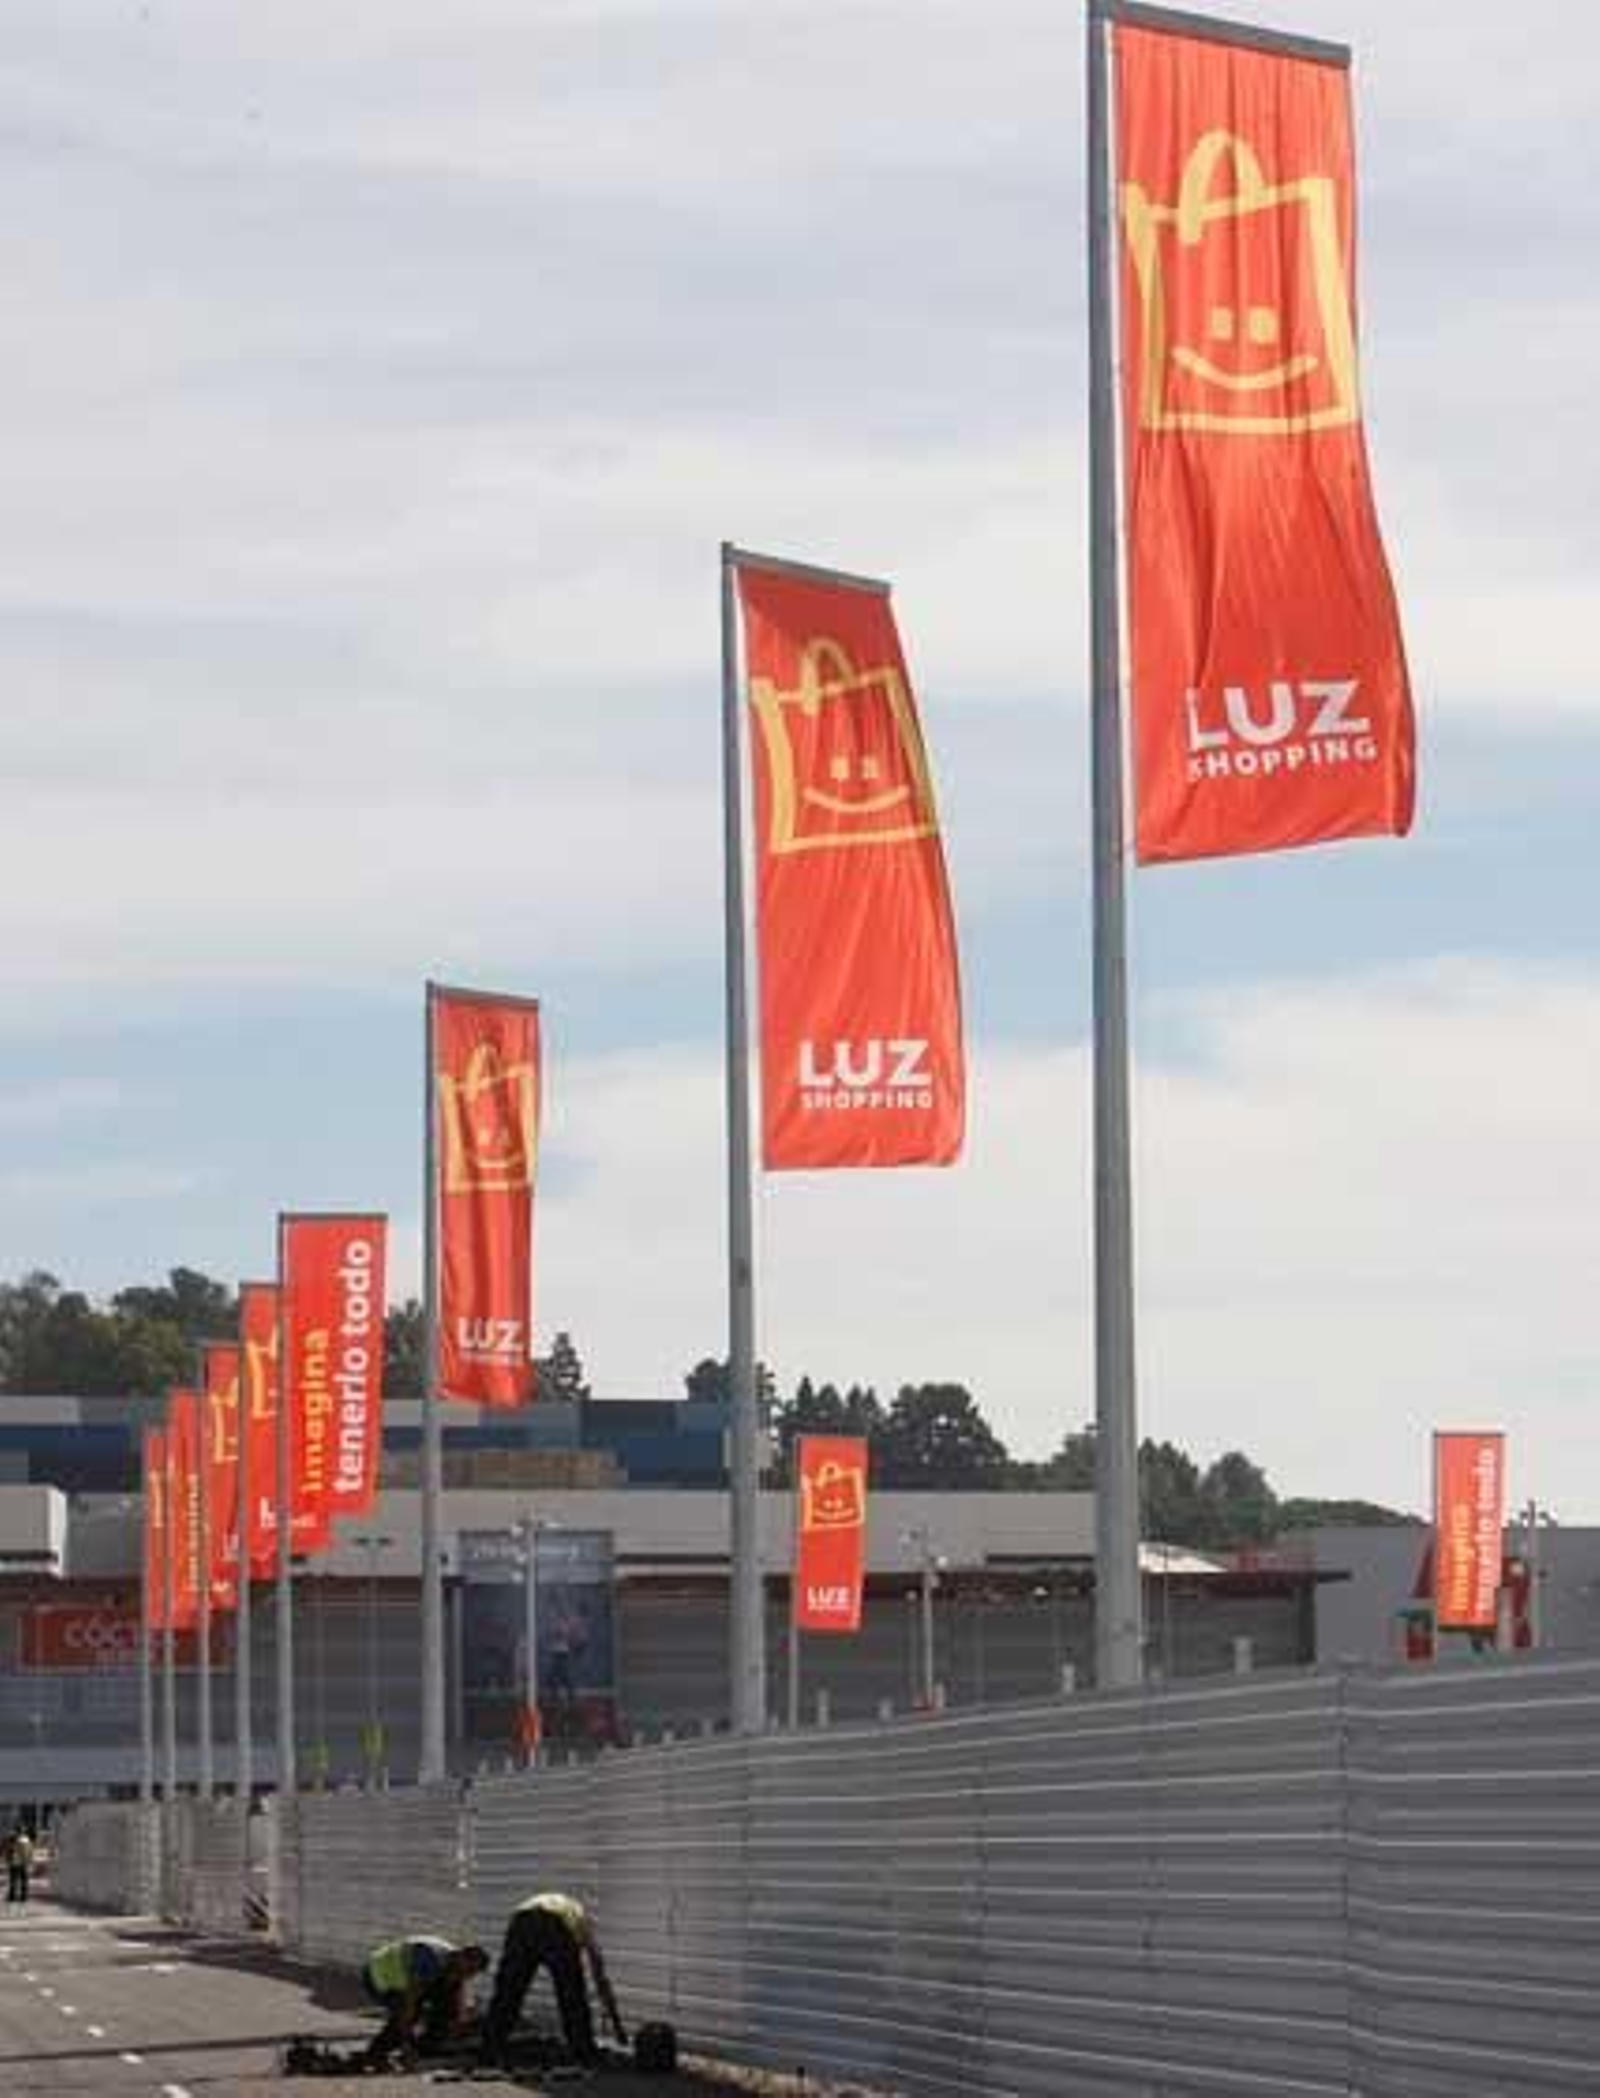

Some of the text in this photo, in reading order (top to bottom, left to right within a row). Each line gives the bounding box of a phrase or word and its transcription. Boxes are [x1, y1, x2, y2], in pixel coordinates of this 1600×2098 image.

[1186, 679, 1371, 752] LUZ
[1187, 736, 1378, 783] SHOPPING
[799, 1038, 932, 1087] LUZ
[801, 1090, 932, 1110] SHOPPING
[458, 1317, 523, 1353] LUZ
[333, 1240, 371, 1493] tenerlo todo
[301, 1328, 333, 1492] imagina
